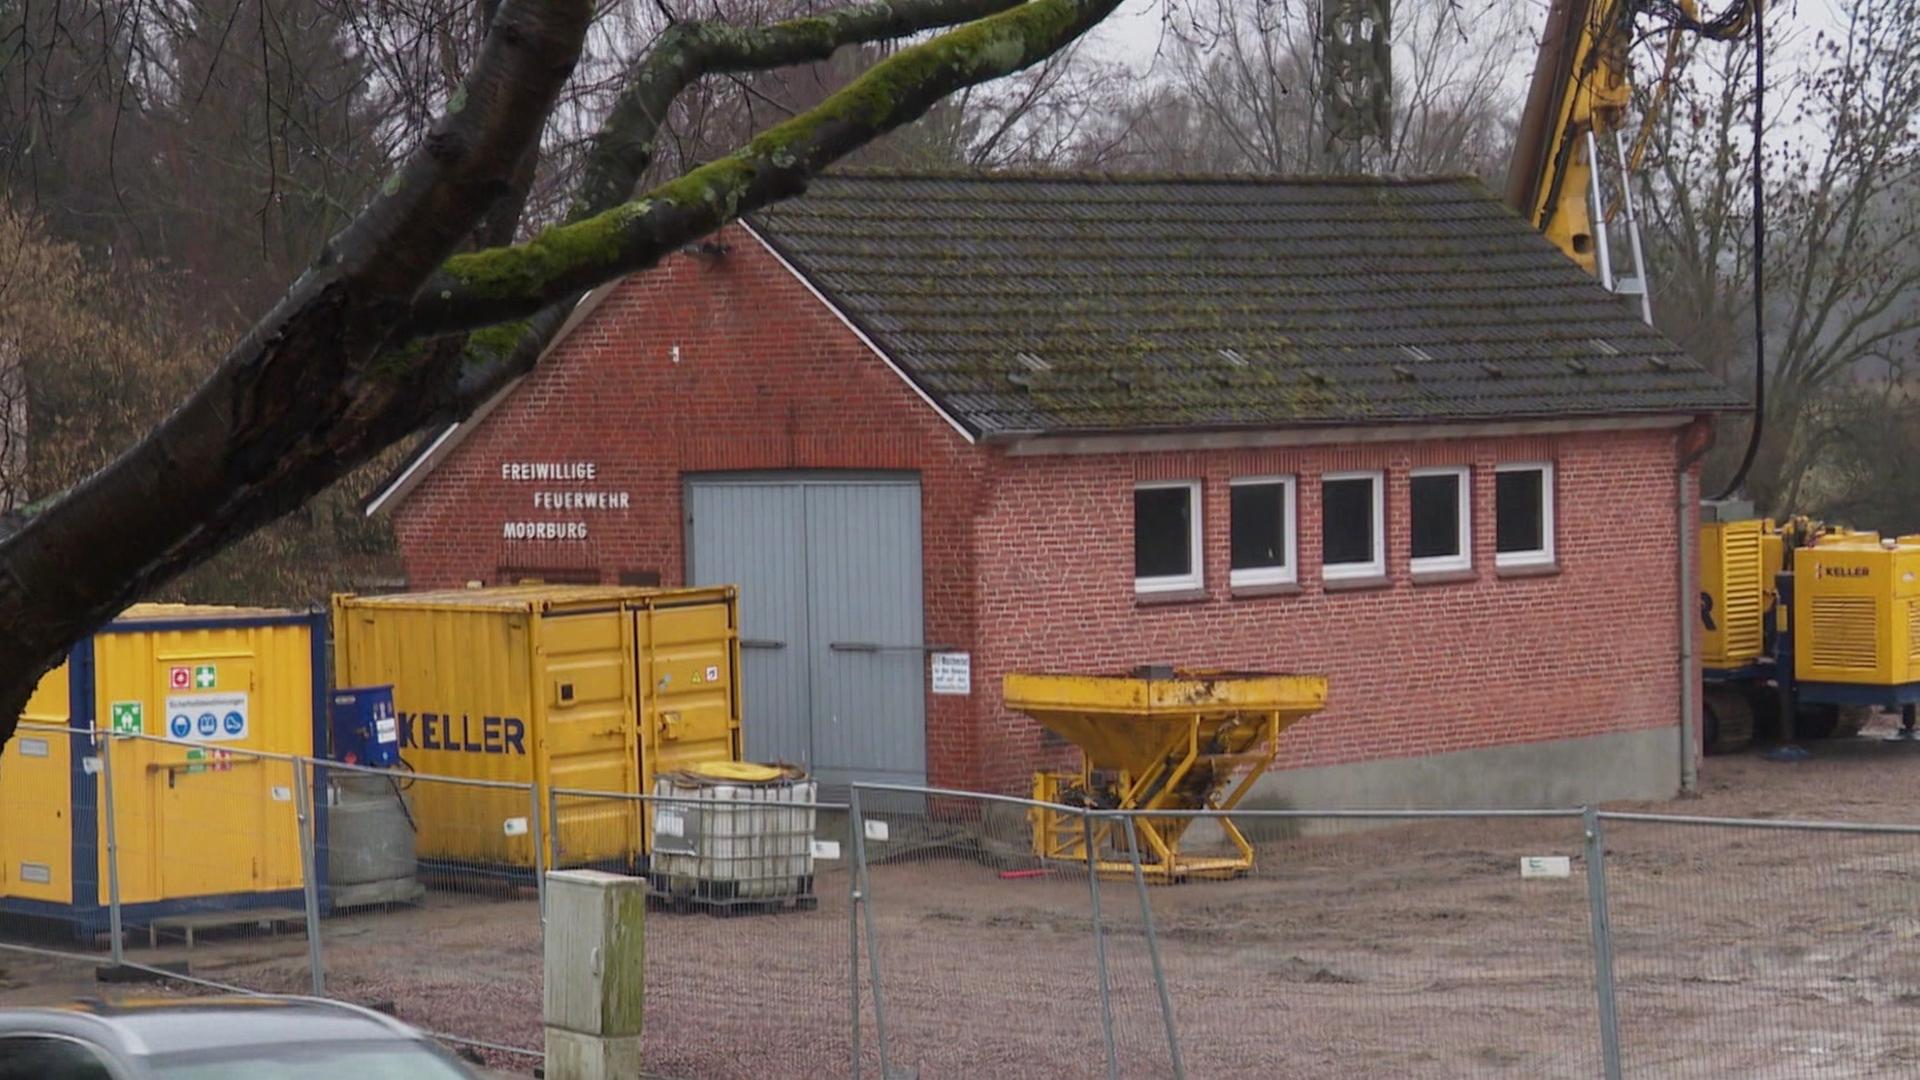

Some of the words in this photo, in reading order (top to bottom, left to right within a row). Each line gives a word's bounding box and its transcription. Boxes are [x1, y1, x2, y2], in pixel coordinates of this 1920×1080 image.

[502, 463, 596, 480] FREIWILLIGE
[534, 491, 630, 509] FEUERWEHR
[503, 522, 588, 539] MOORBURG
[1826, 567, 1869, 577] KELLER
[398, 712, 525, 755] KELLER
